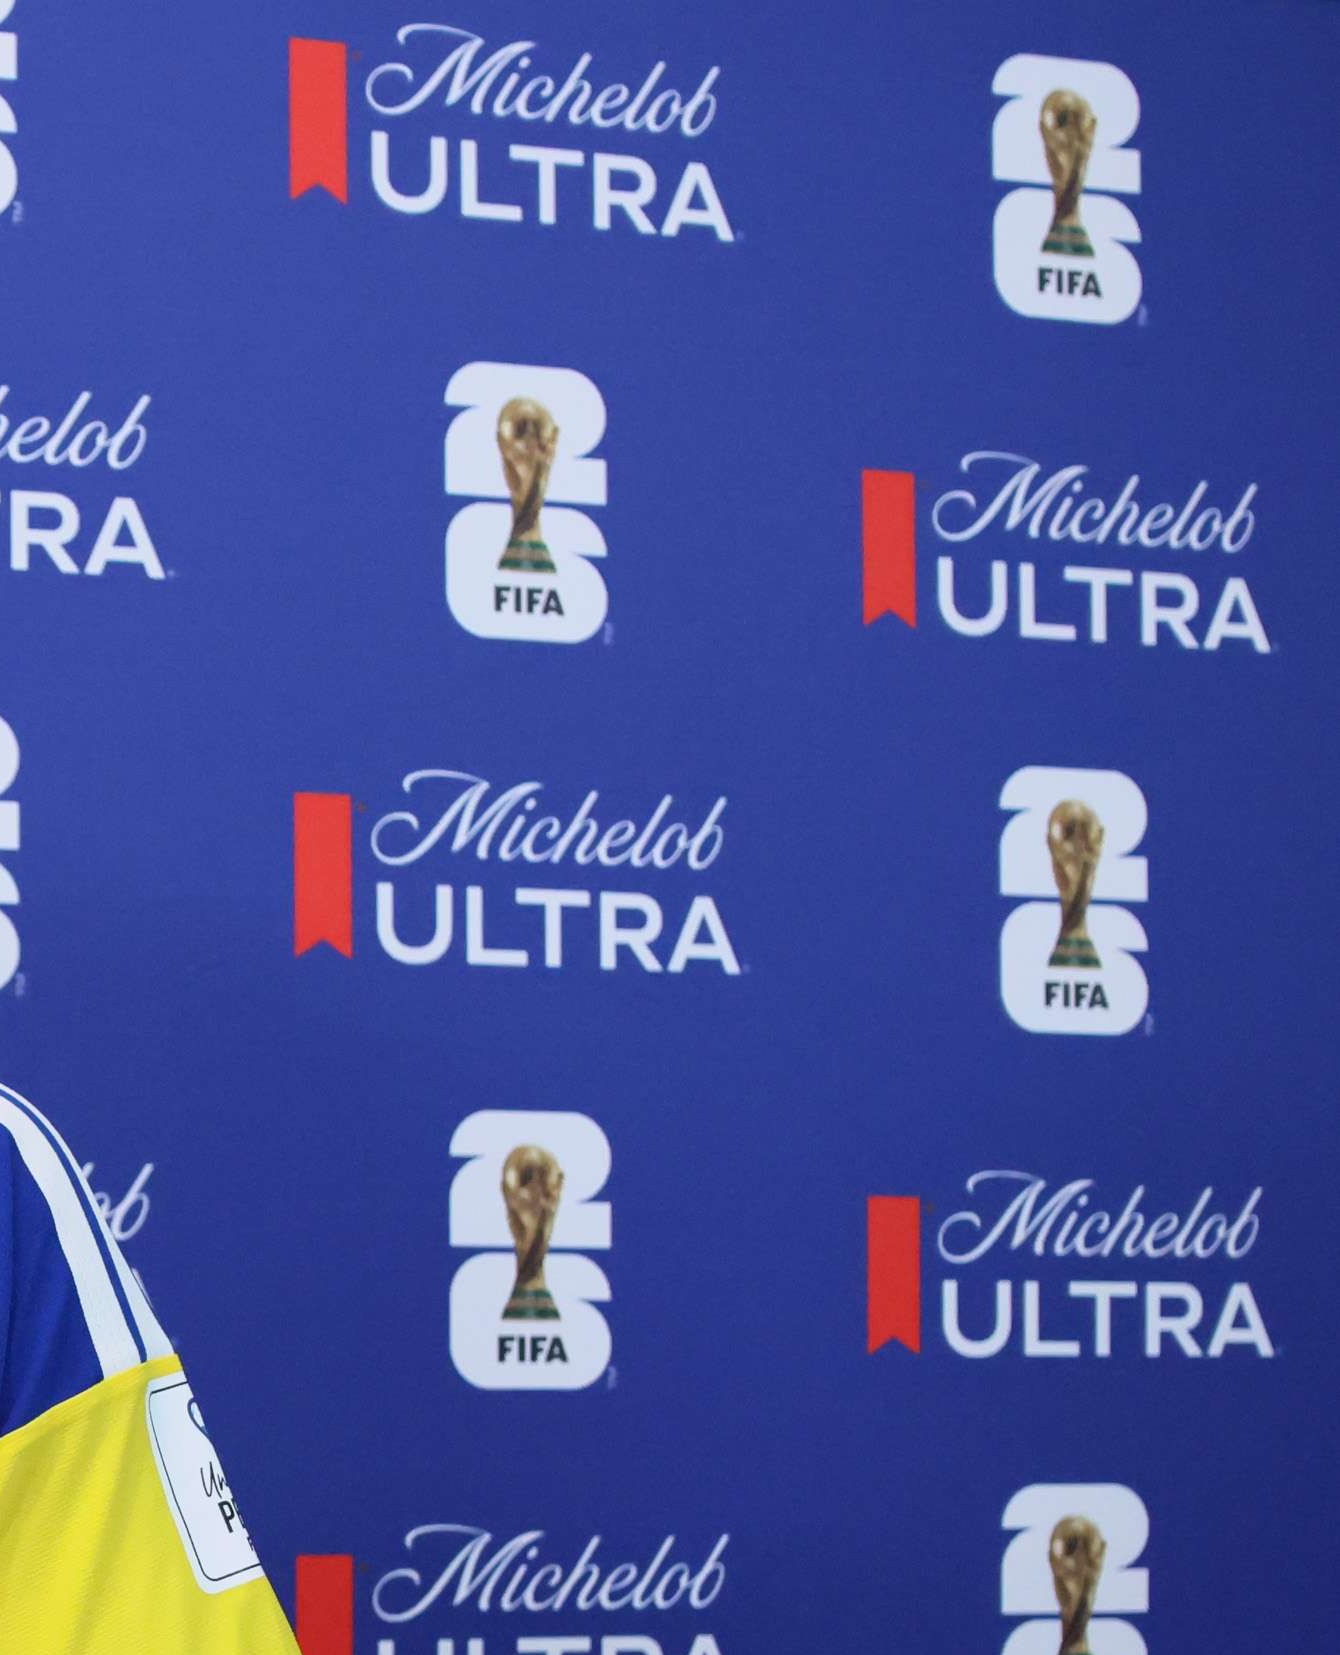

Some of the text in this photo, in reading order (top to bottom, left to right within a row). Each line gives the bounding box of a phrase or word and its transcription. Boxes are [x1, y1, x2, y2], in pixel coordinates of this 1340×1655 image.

[365, 22, 721, 138] Michelob
[371, 124, 734, 242] ULTRA
[1038, 267, 1102, 298] FIFA
[931, 450, 1258, 561] Michelob
[494, 586, 564, 616] FIFA
[937, 556, 1271, 654] ULTRA
[370, 768, 727, 870] Michelob
[376, 882, 741, 975] ULTRA
[1045, 982, 1108, 1008] FIFA
[937, 1170, 1263, 1264] Michelob
[498, 1336, 567, 1363] FIFA
[942, 1279, 1274, 1358] ULTRA
[372, 1523, 730, 1623] Michelob
